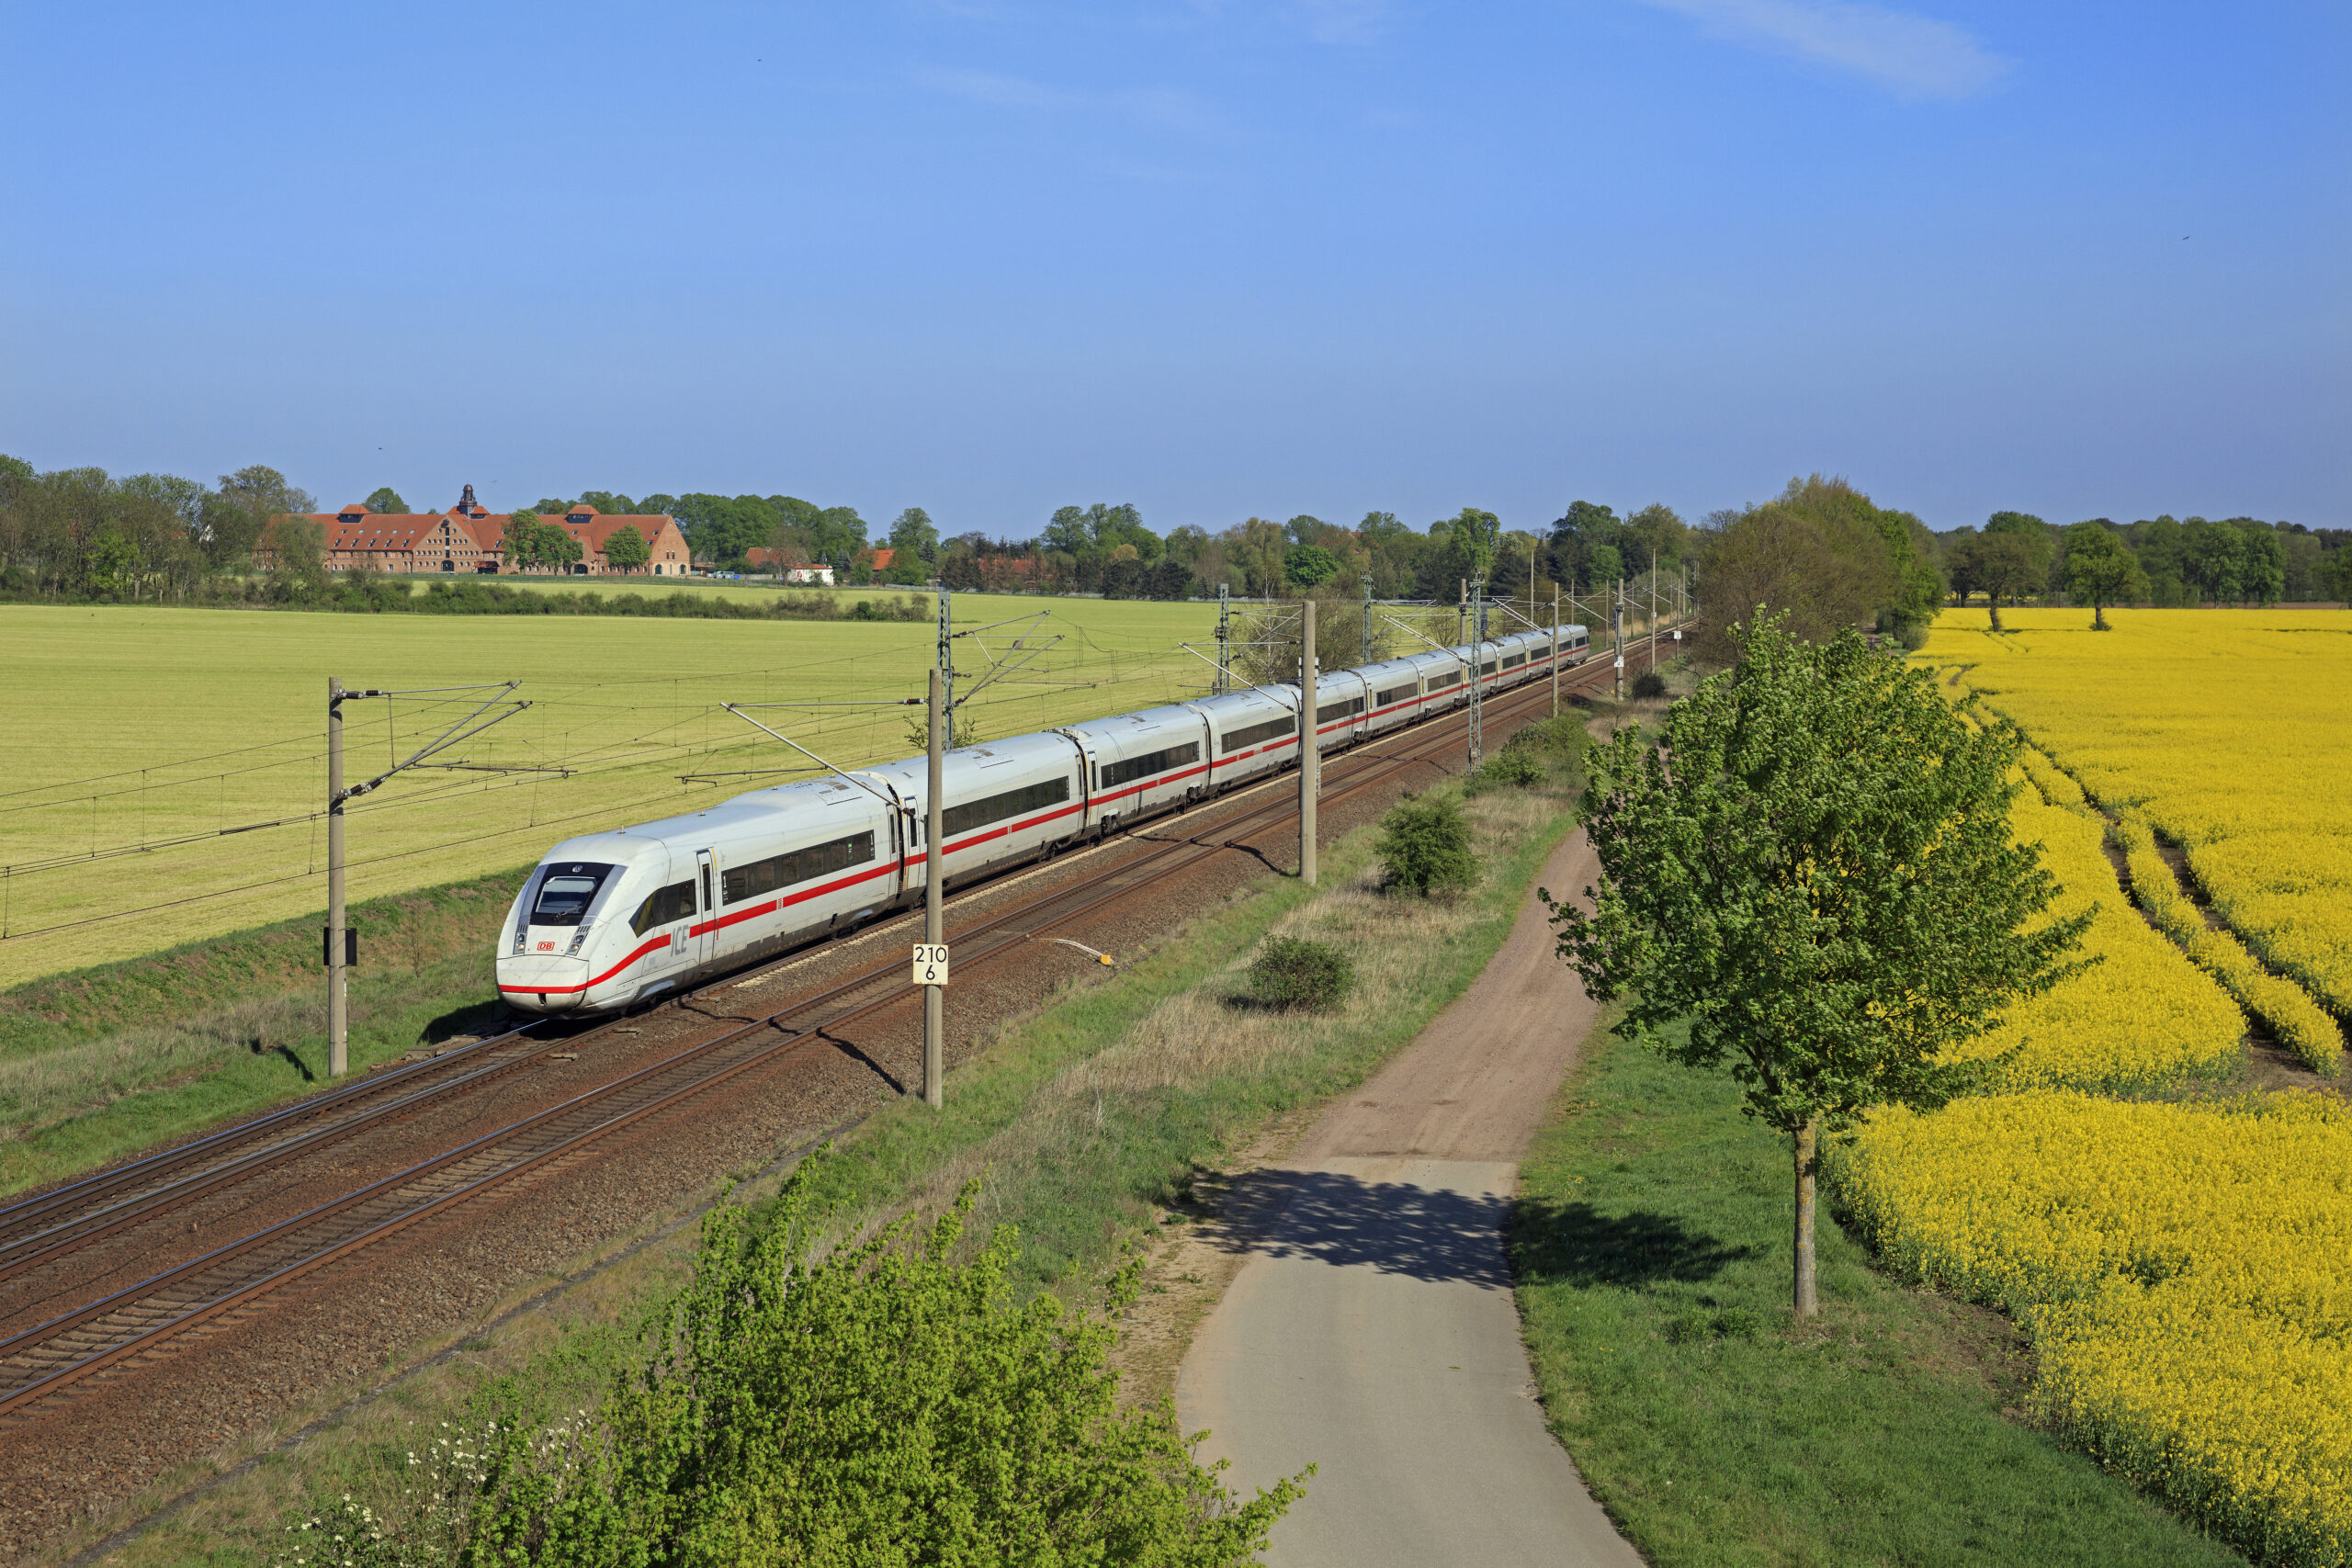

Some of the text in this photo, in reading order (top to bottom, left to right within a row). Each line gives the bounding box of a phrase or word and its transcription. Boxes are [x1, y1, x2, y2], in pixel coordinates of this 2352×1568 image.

[671, 924, 689, 956] ICE
[915, 947, 947, 963] 210
[926, 964, 935, 980] 6
